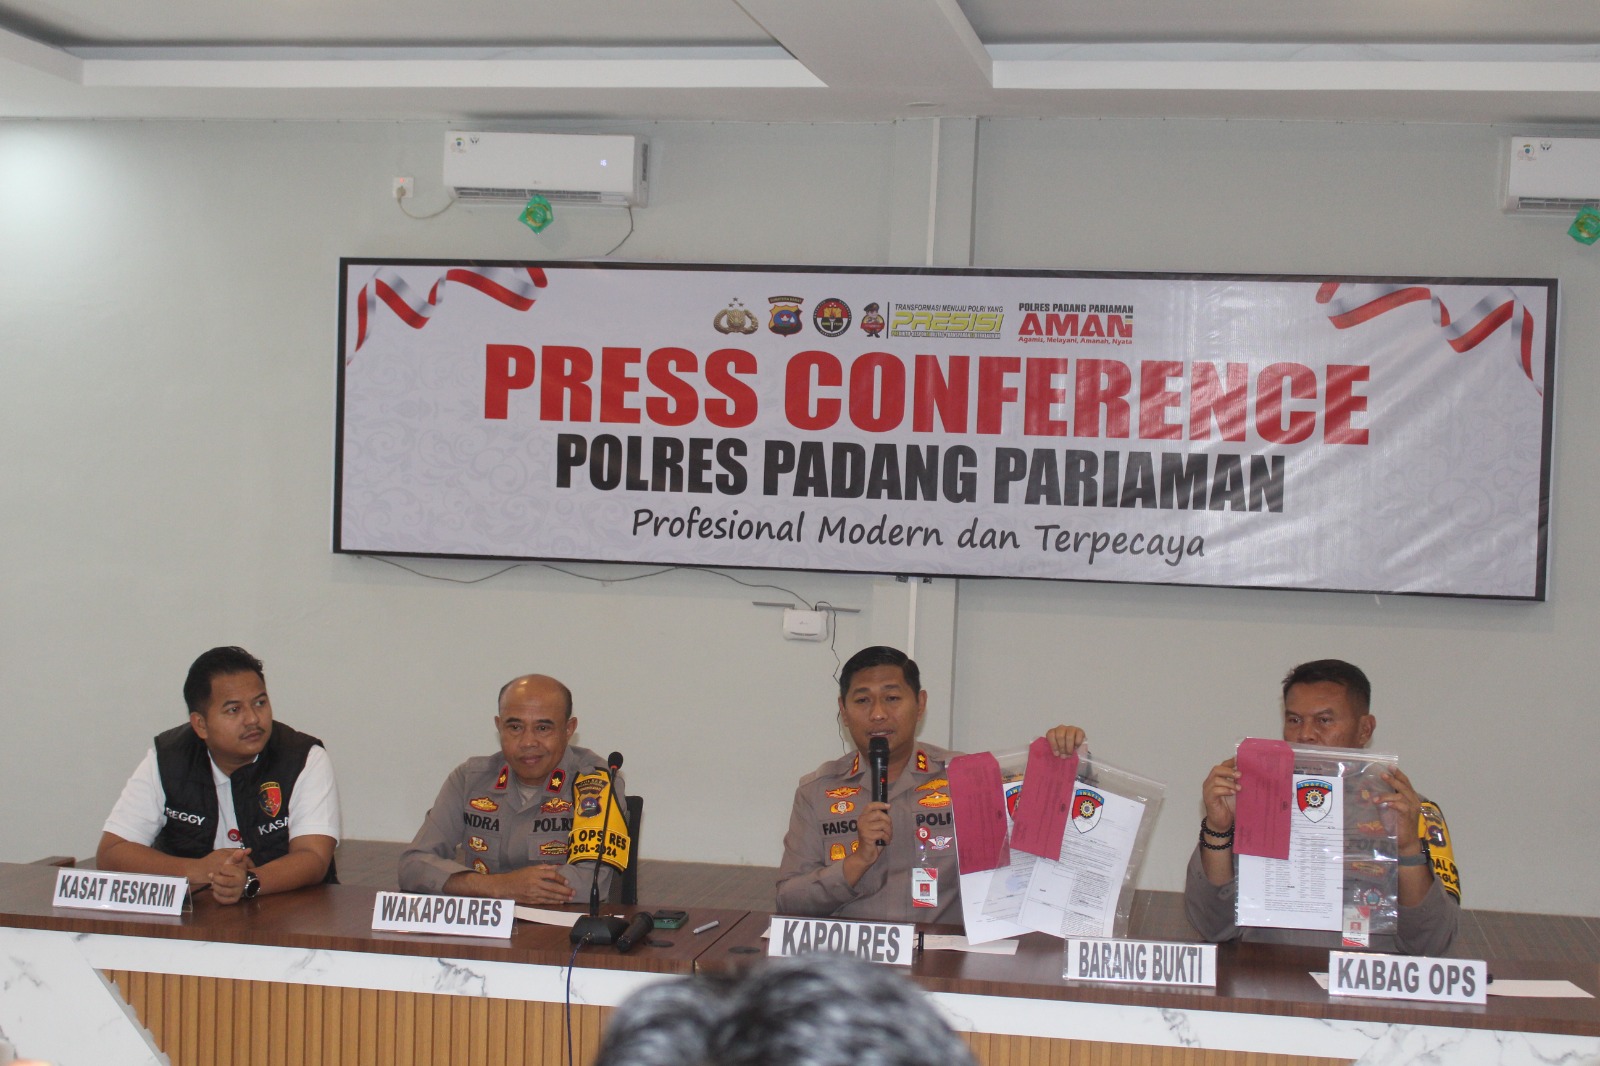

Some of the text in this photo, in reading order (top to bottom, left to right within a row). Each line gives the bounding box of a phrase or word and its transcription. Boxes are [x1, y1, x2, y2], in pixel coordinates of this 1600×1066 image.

[891, 311, 1004, 332] PRESISI
[895, 303, 941, 311] TRANSFORMASI
[968, 305, 987, 313] POLRI
[1019, 303, 1133, 314] POLRES PADANG PARIAMAN
[1018, 313, 1133, 338] AMAN
[1046, 337, 1079, 345] Melayani,
[1112, 338, 1133, 346] Nyata
[485, 344, 1370, 445] PRESS CONFERENCE
[557, 434, 1285, 513] POLRES PADANG PARIAMAN
[633, 506, 1205, 567] Profesional Modern dan Terpecaya
[166, 807, 206, 826] REGGY
[579, 830, 604, 843] OPS
[609, 833, 627, 851] RES
[59, 875, 177, 907] KASAT RESKRIM
[381, 896, 502, 927] WAKAPOLRES
[781, 920, 901, 963] KAPOLRES
[1078, 941, 1203, 984] BARANG BUKTI
[1338, 958, 1476, 998] KABAG OPS
